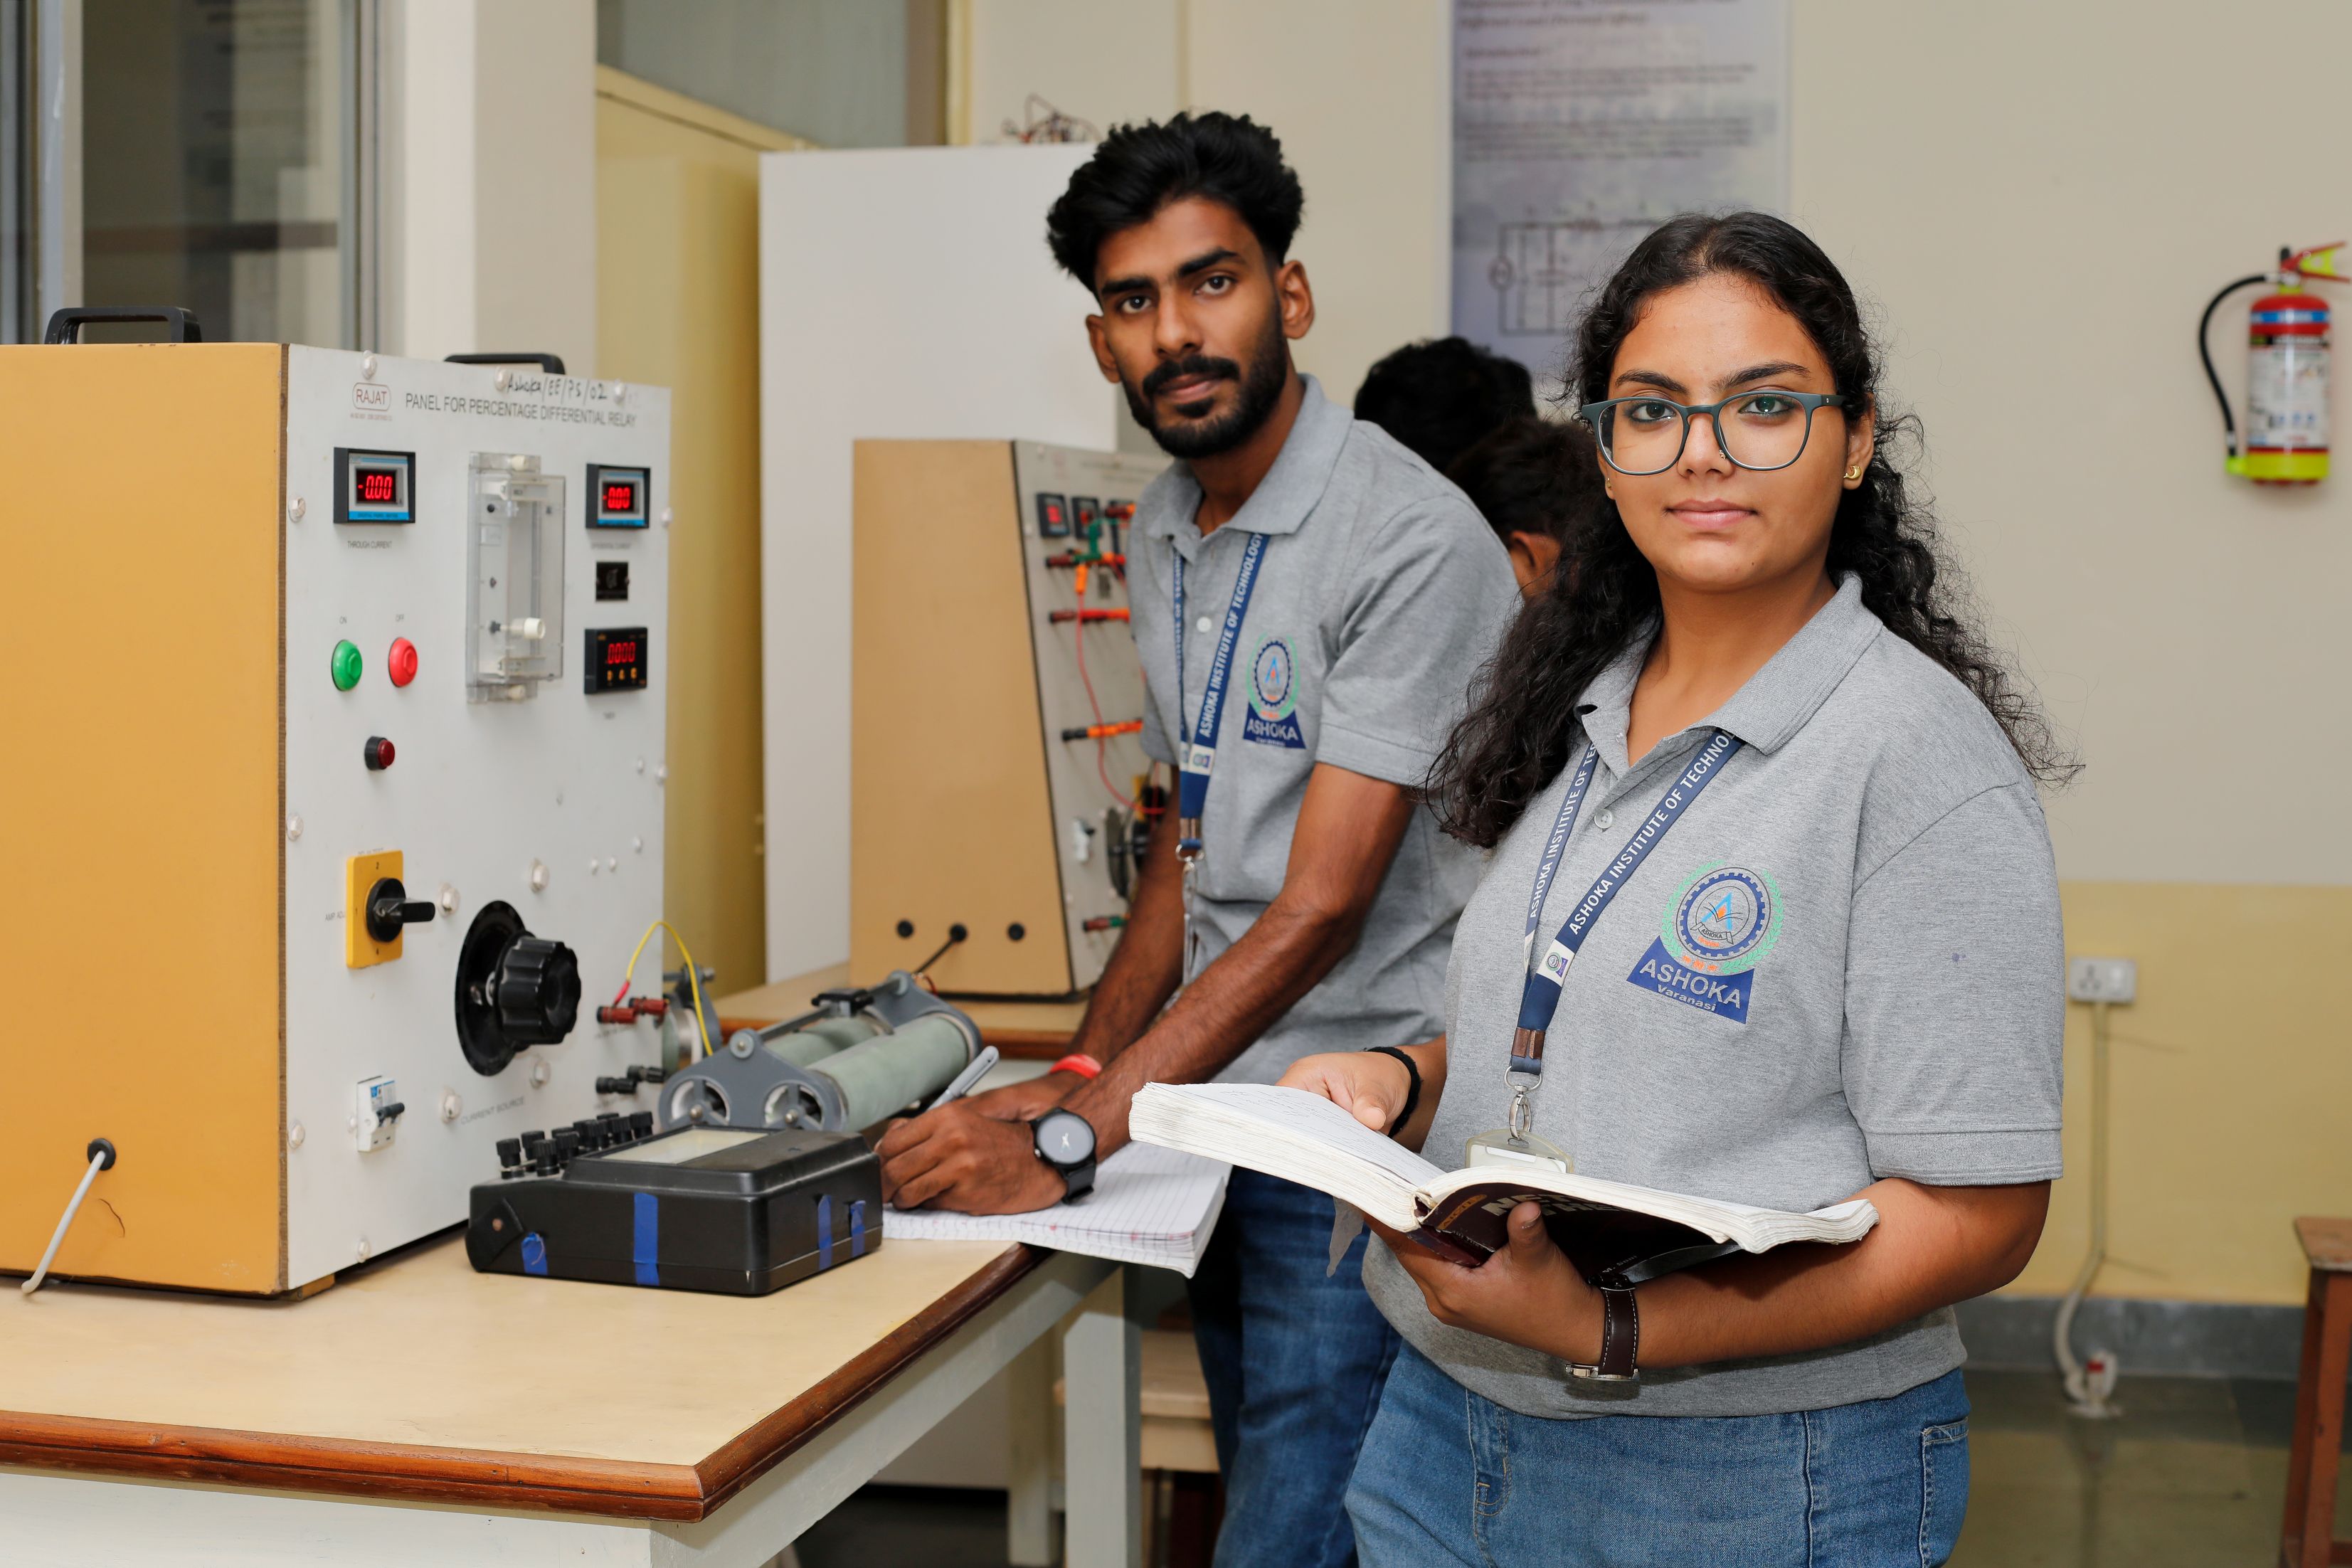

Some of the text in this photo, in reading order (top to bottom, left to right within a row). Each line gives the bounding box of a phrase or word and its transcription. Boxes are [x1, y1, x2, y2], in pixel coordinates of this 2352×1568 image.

[356, 388, 387, 405] RAJAT
[406, 393, 637, 427] PANEL FOR PERCENTAGE DIFFERENTIAL RELAY
[347, 541, 393, 549] THROUGH CURRENT
[1199, 690, 1219, 738] ASHOKA
[1210, 628, 1234, 690] INSTITUTE
[1227, 610, 1239, 628] OF
[1246, 719, 1299, 741] ASHOKA
[1530, 862, 1553, 918] ASHOKA
[1546, 790, 1581, 859] INSTITUTE
[1574, 770, 1587, 787] OF
[1569, 879, 1614, 935] ASHOKA
[1609, 809, 1669, 879] INSTITUTE
[1665, 788, 1683, 810] OF
[1700, 928, 1723, 939] ASHOKA
[1639, 958, 1741, 1010] ASHOKA
[1657, 984, 1717, 1012] Varanasi
[461, 1096, 524, 1124] CURRENT SOURCE
